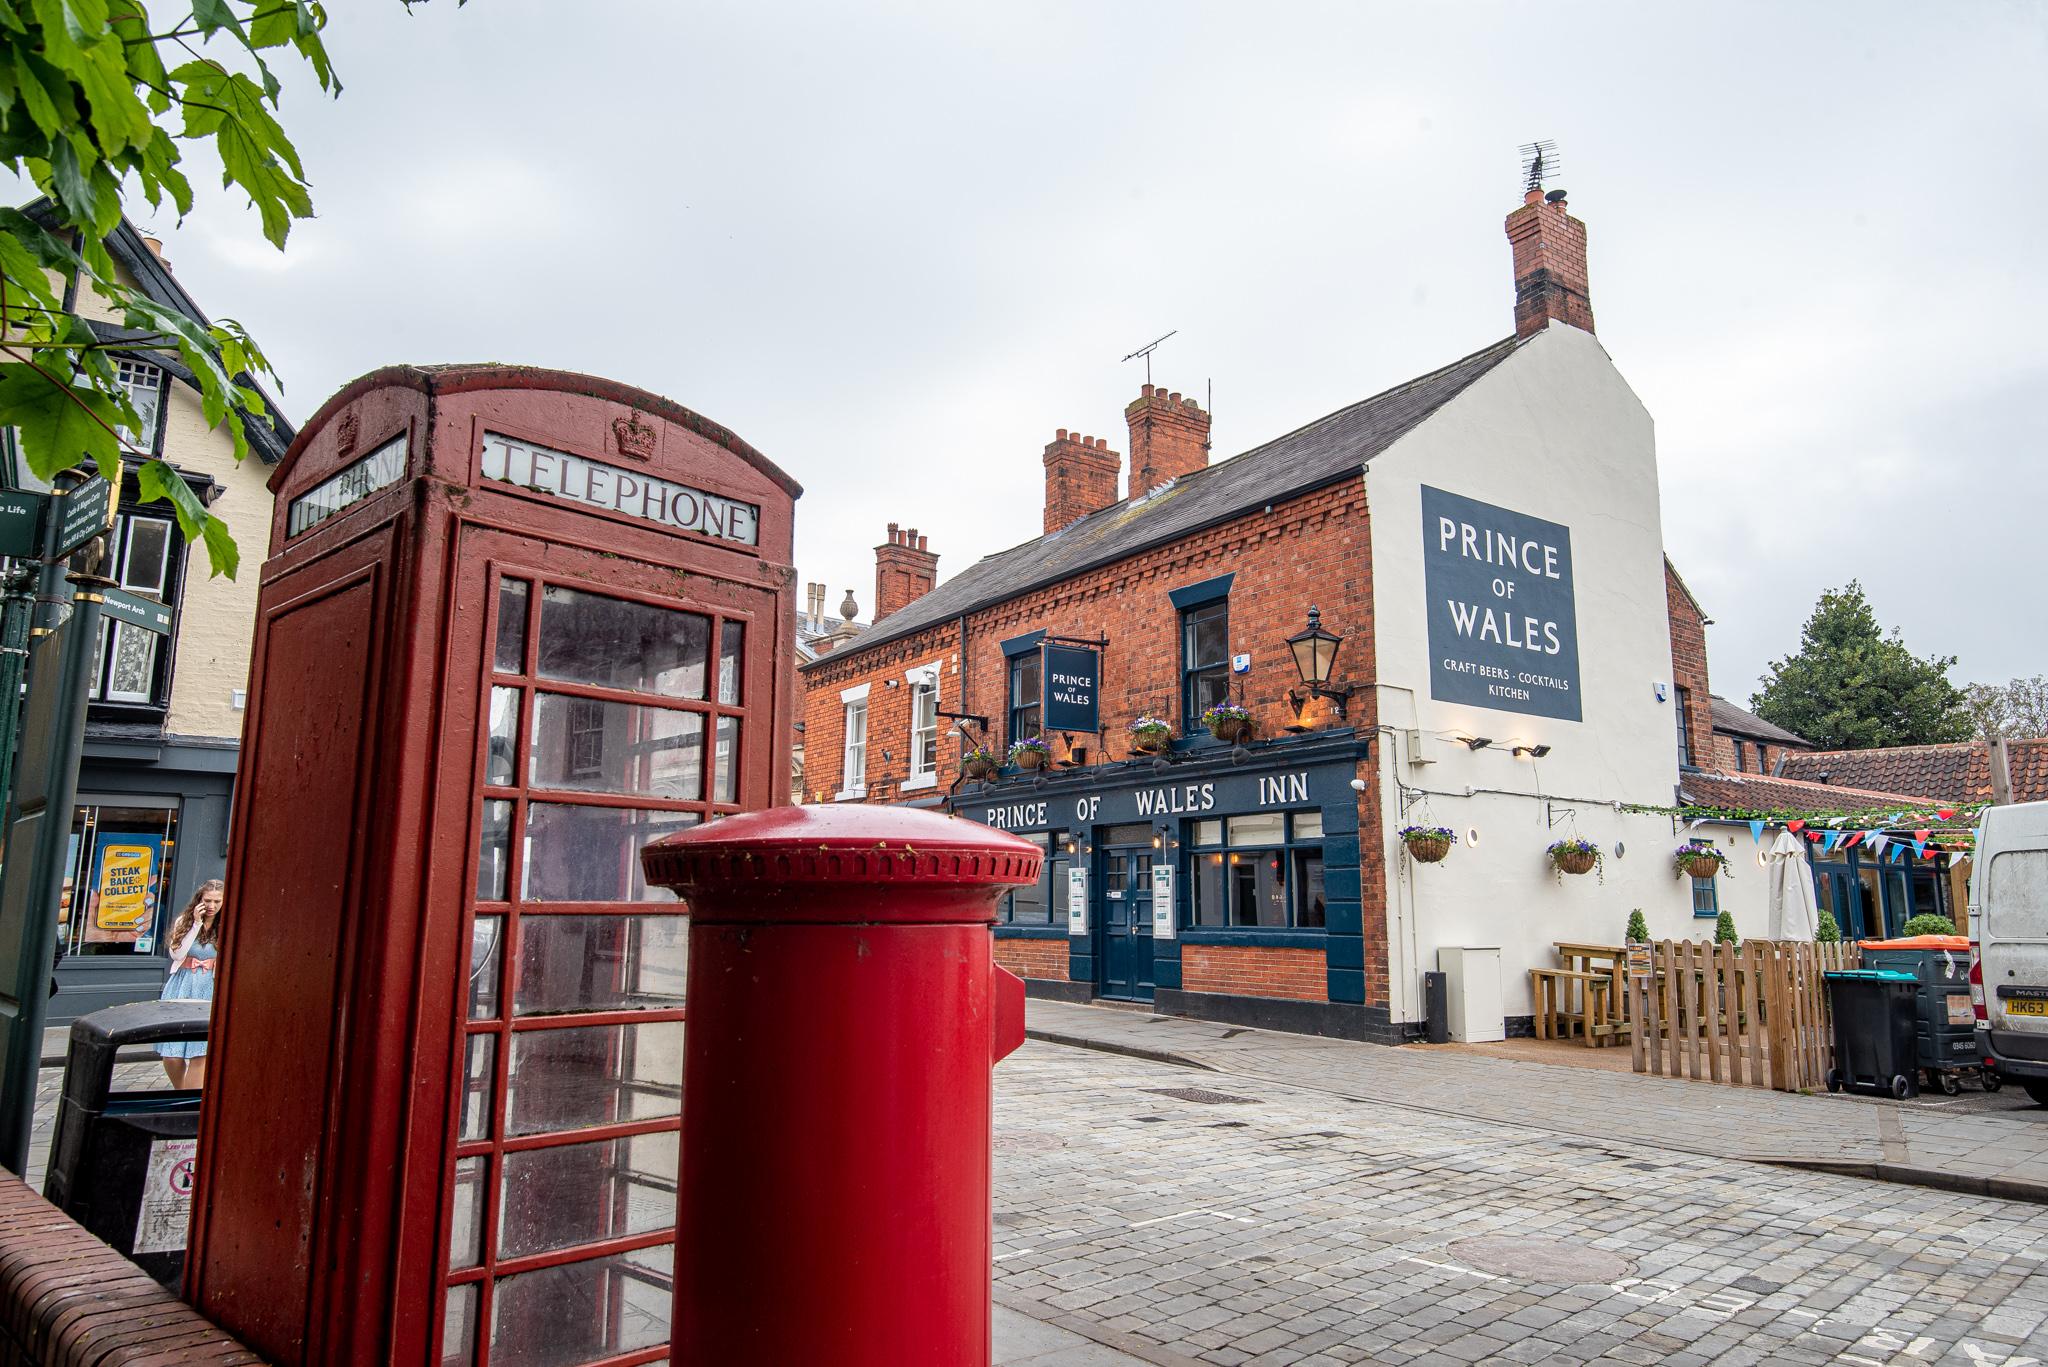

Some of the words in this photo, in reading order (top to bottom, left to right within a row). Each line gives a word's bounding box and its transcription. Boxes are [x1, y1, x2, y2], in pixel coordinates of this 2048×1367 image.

[493, 441, 748, 541] TELEPHONE
[8, 505, 26, 515] Life
[1439, 516, 1560, 580] PRINCE
[1492, 578, 1515, 600] OF
[104, 595, 131, 611] Newport
[132, 605, 145, 616] Arch
[1447, 599, 1561, 656] WALES
[1052, 673, 1091, 687] PRINCE
[1443, 658, 1477, 675] CRAFT
[1479, 665, 1510, 680] BEERS
[1518, 672, 1569, 691] COCKTAILS
[1053, 691, 1090, 705] WALES
[1488, 684, 1530, 700] KITCHEN
[986, 801, 1048, 829] PRINCE
[1076, 796, 1101, 821] OF
[1134, 782, 1215, 816] WALES
[1259, 772, 1309, 805] INN
[110, 866, 141, 877] STEAK
[104, 885, 145, 896] COLLECT
[2011, 1001, 2044, 1014] HK63
